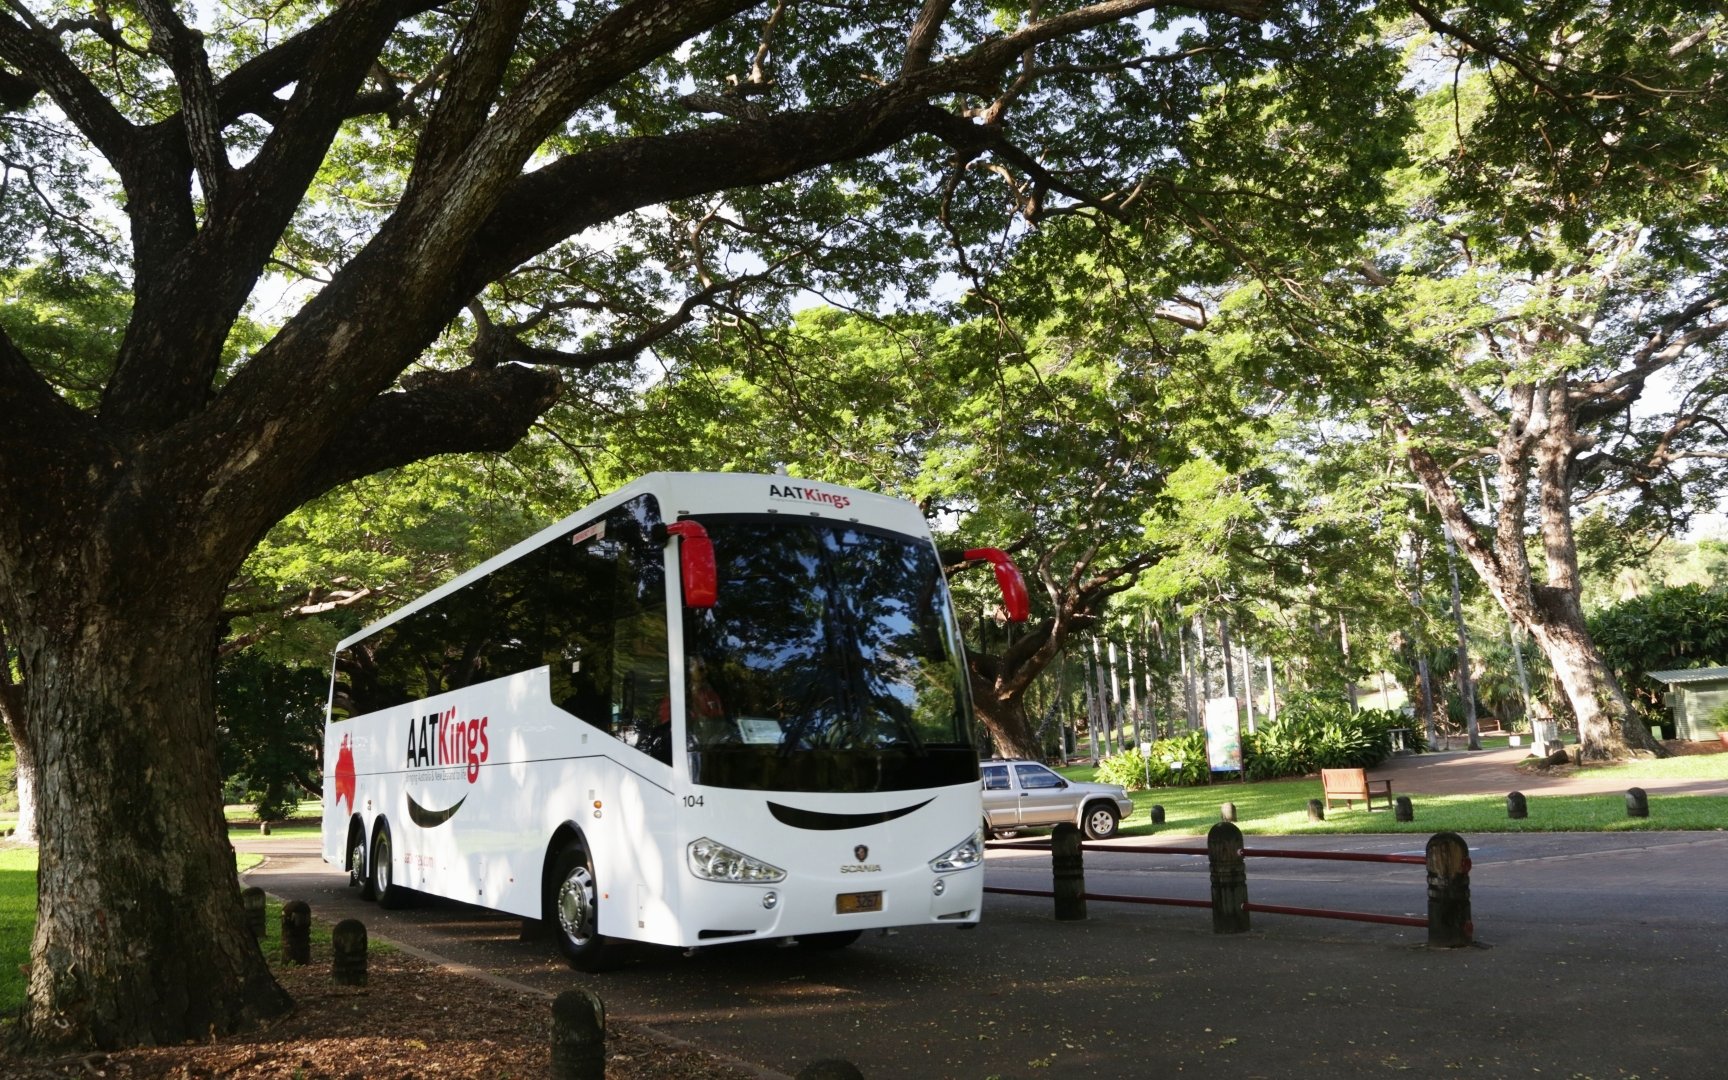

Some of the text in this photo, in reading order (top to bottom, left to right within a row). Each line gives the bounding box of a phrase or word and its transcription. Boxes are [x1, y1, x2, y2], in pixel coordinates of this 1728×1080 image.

[769, 484, 850, 509] AATKings
[406, 705, 489, 784] AATKings
[683, 795, 704, 807] 104
[840, 864, 882, 873] SCANIA
